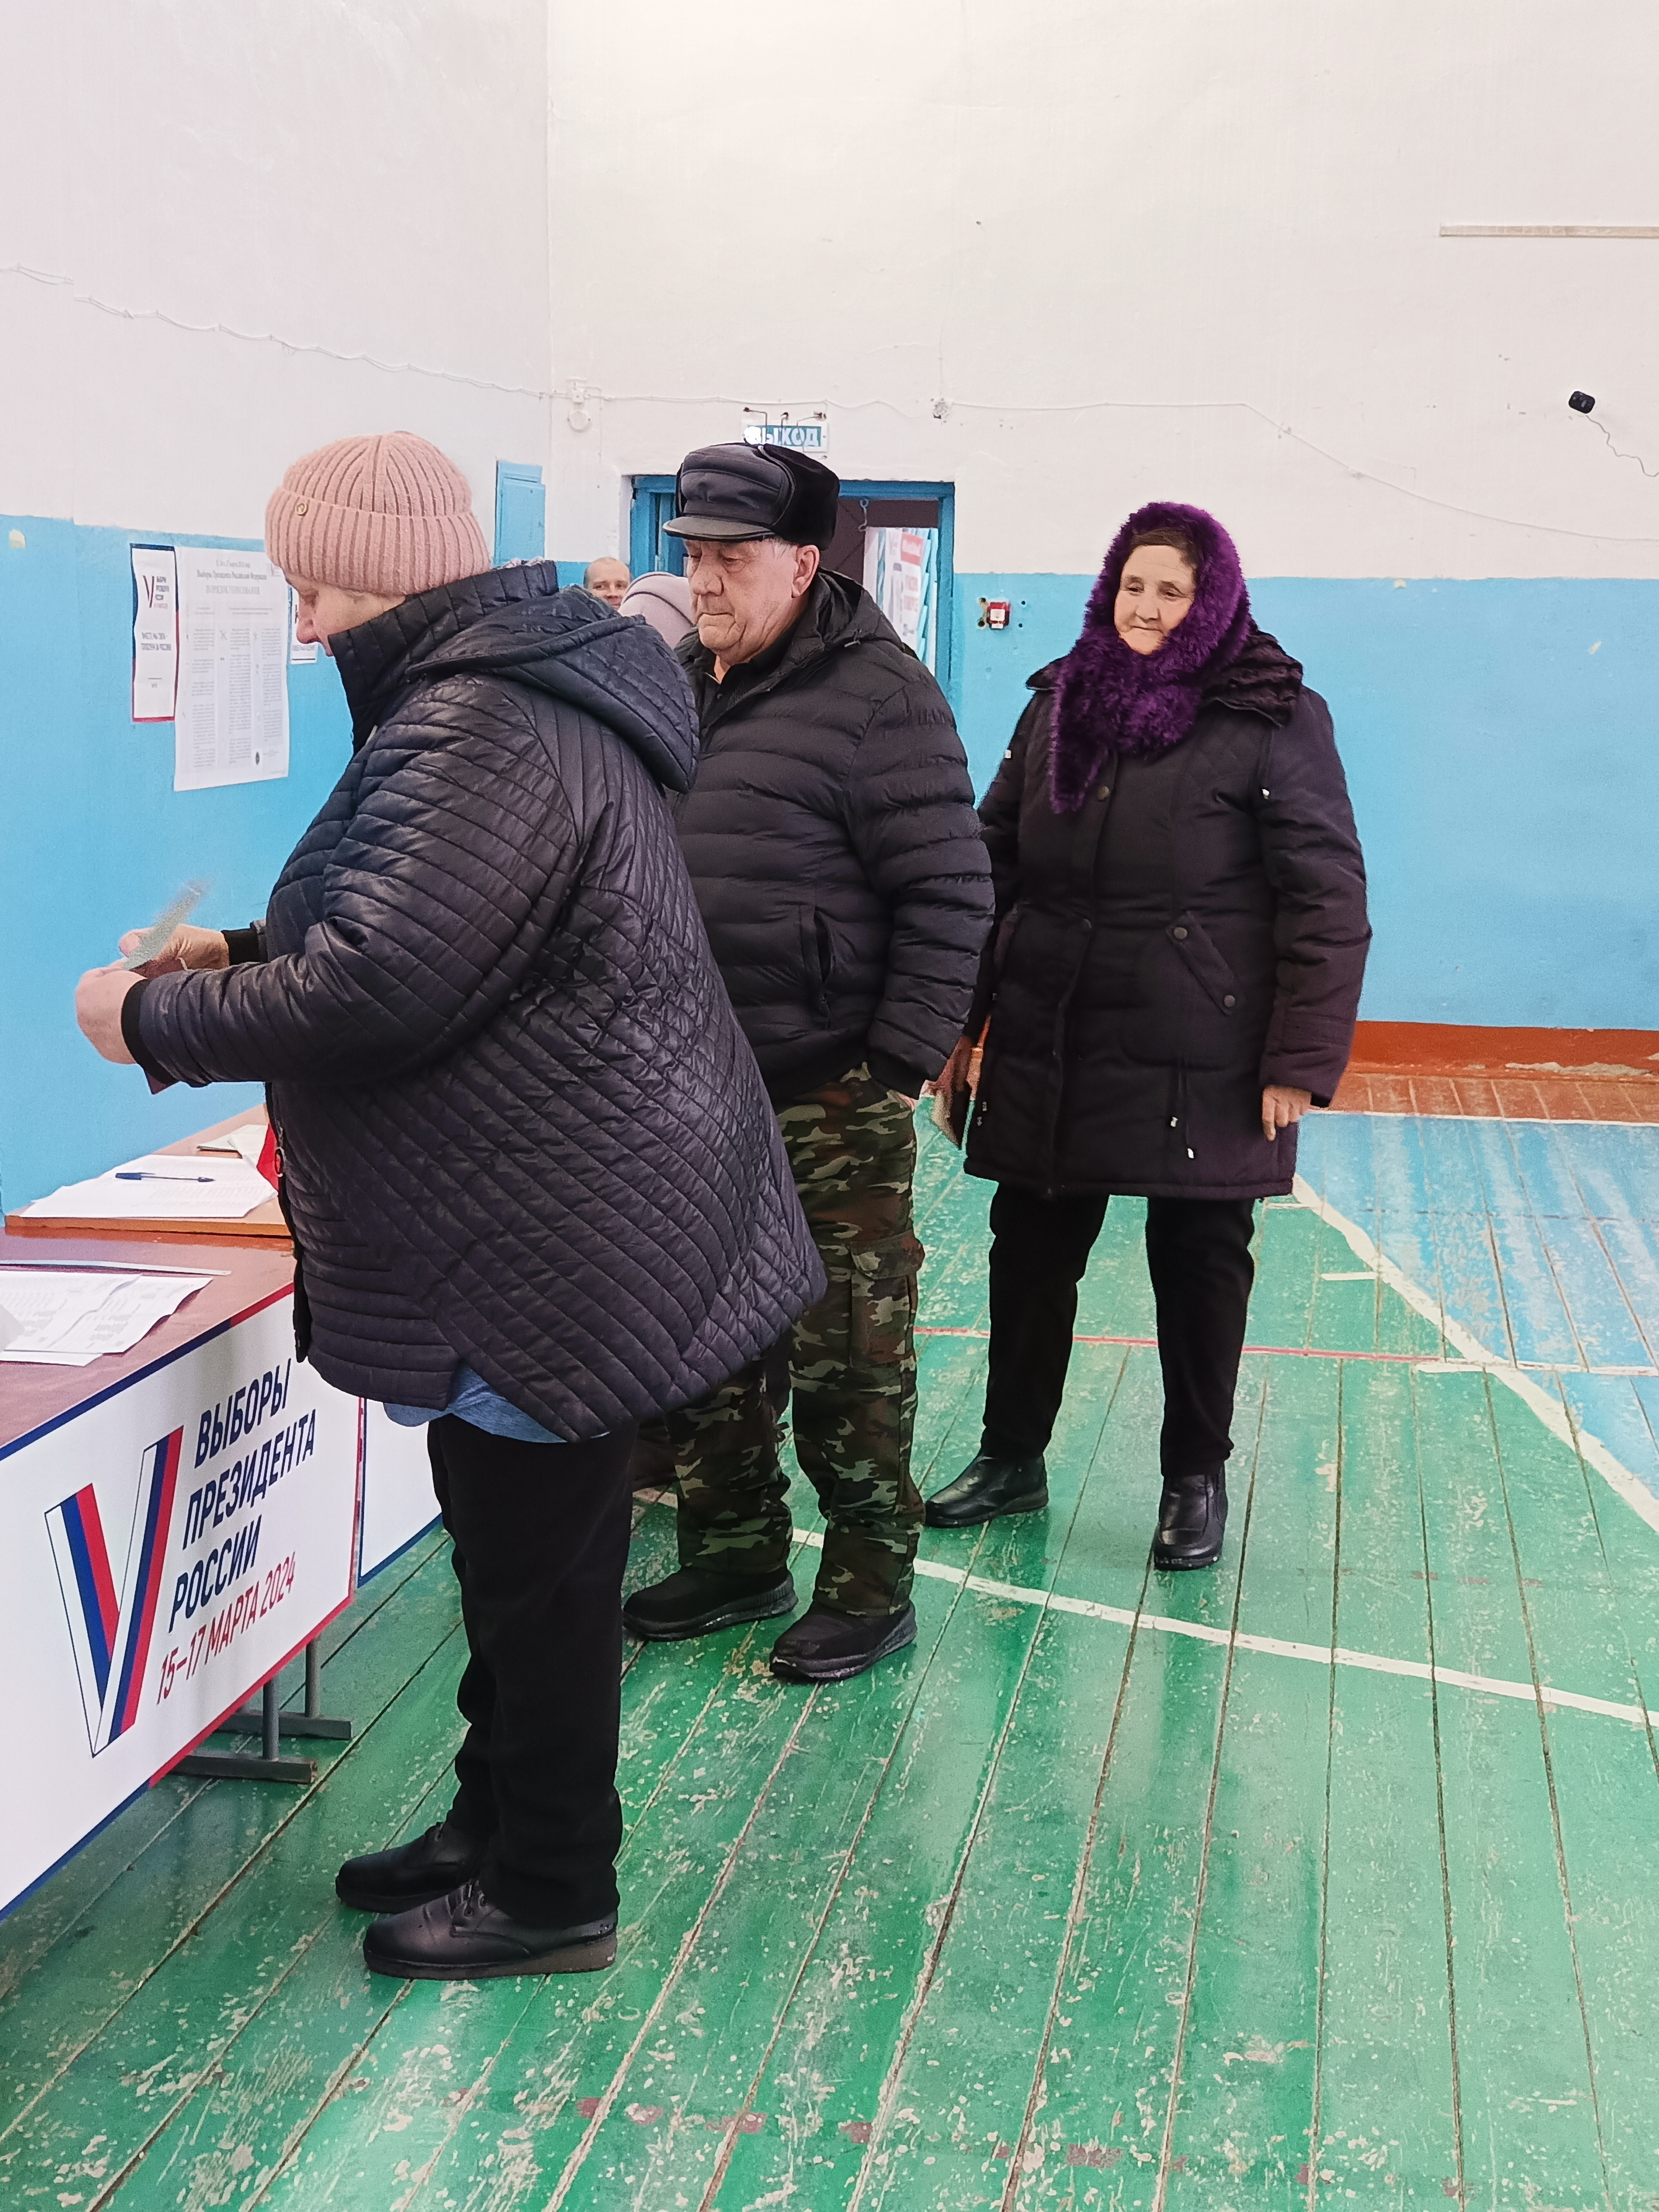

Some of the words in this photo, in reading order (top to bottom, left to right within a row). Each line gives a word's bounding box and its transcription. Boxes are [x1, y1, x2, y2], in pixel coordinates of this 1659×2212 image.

[747, 427, 819, 447] ЫХОД
[194, 1357, 292, 1469] ВЫБОРЫ
[182, 1408, 316, 1551] ПРЕЗИДЕНТА
[168, 1513, 262, 1634] РОССИИ
[188, 1580, 260, 1666] МАРТА
[260, 1550, 296, 1619] 2024
